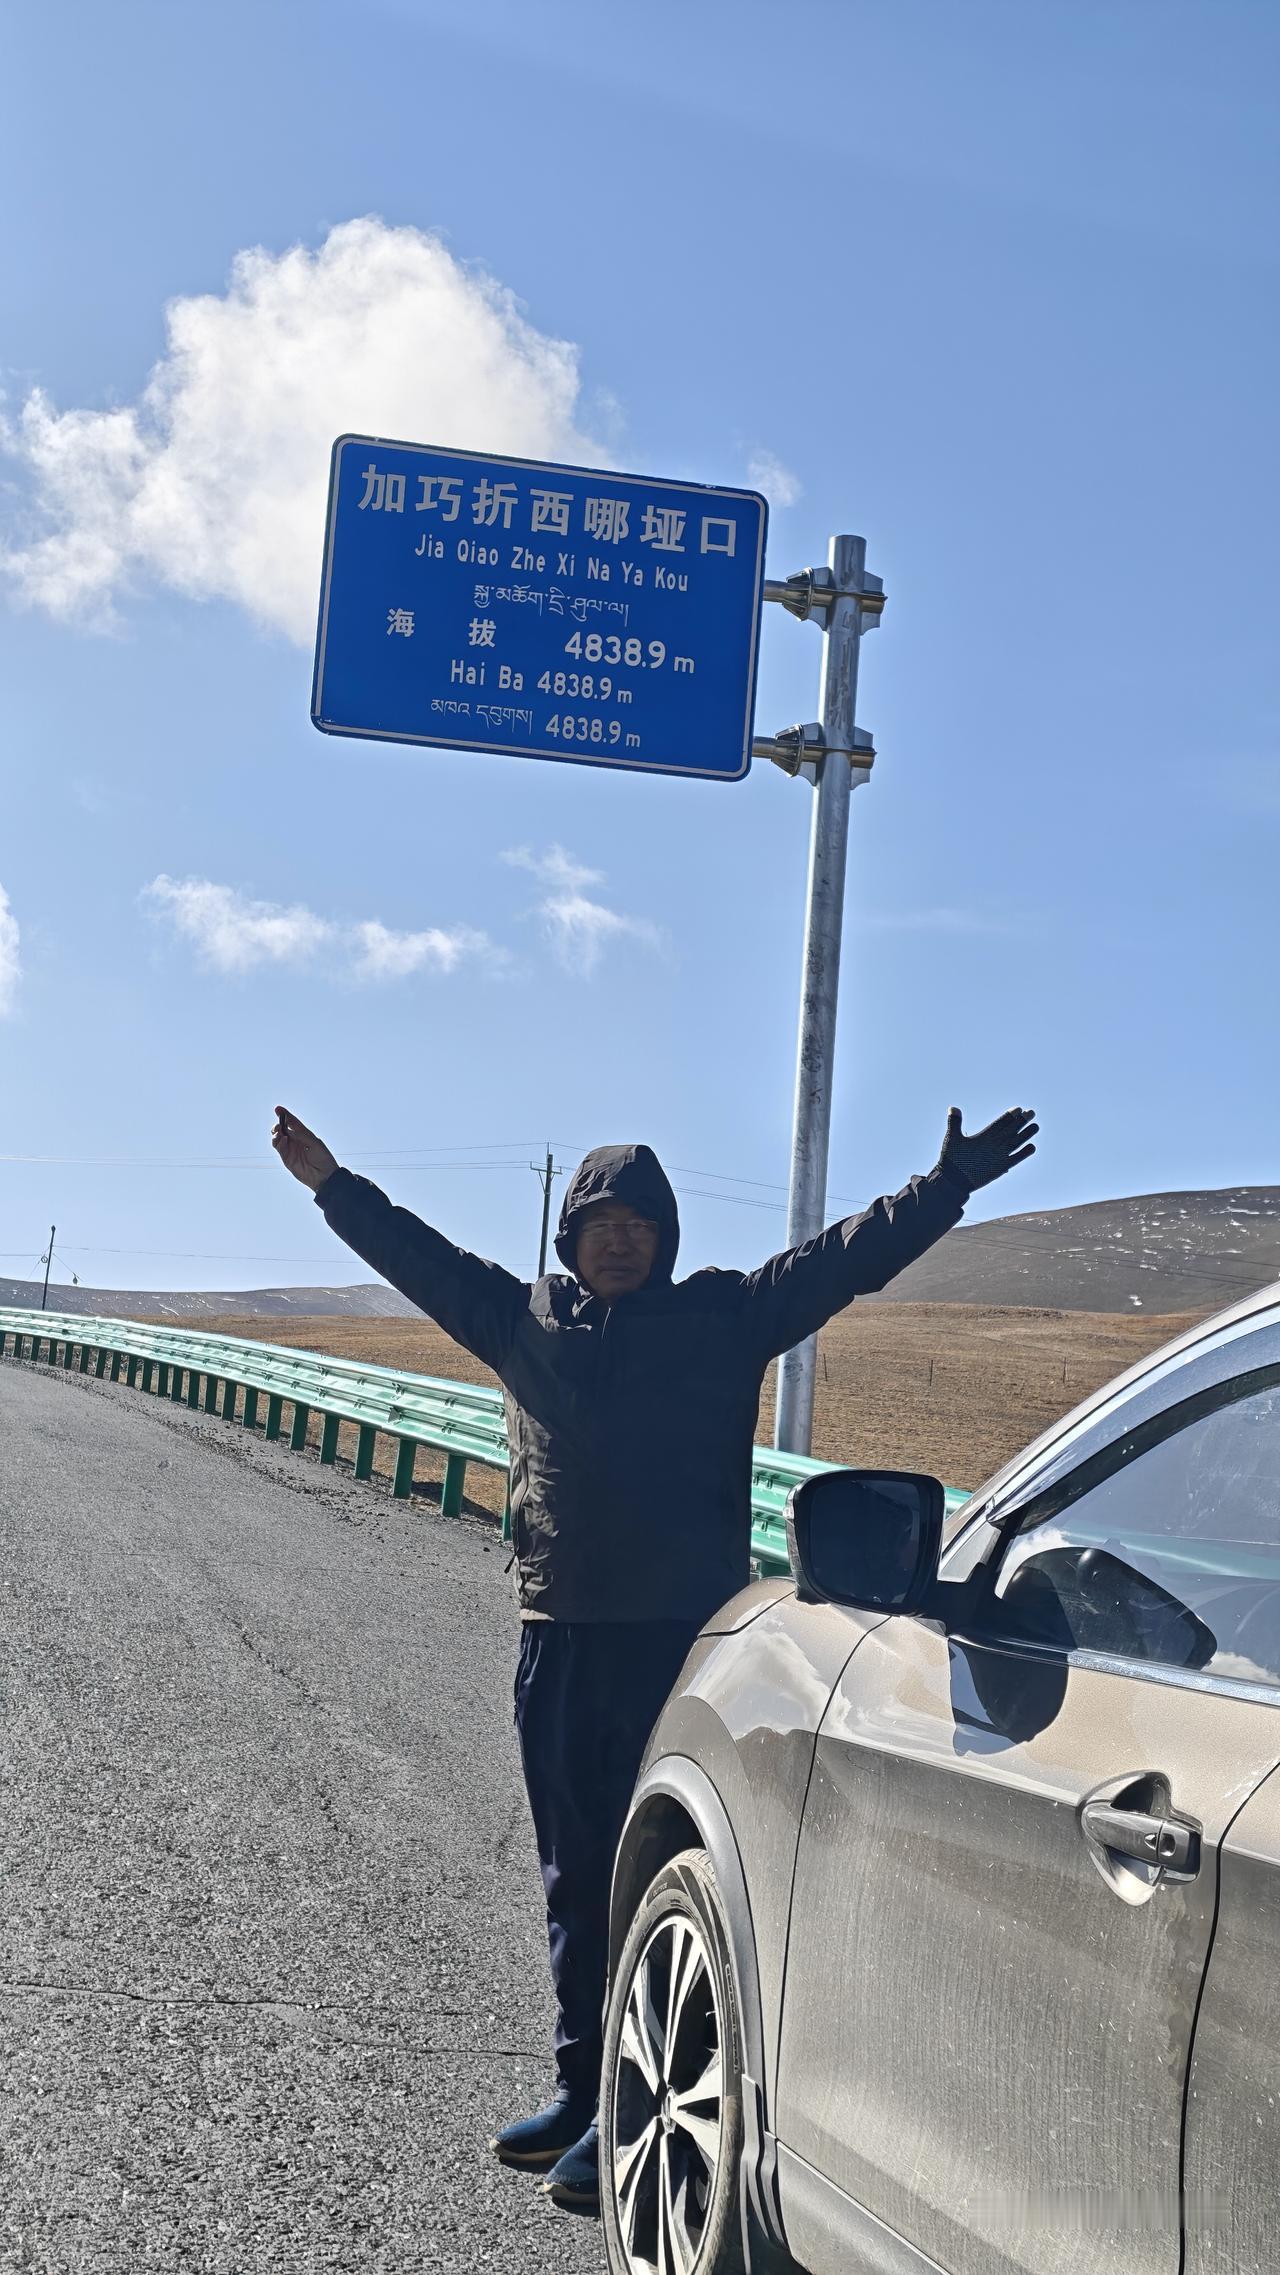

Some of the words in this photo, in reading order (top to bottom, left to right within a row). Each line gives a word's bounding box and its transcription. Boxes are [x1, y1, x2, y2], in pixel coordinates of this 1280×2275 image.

[357, 463, 737, 557] 加巧折西哪垭口
[414, 533, 444, 559] Jia
[457, 539, 499, 567] Qiao
[510, 546, 546, 573] Zhe
[556, 552, 576, 577] Xi
[587, 557, 610, 582] Na
[621, 561, 644, 586] Ya
[654, 566, 689, 592] Kou
[450, 659, 486, 686] Hai
[498, 665, 525, 692] Ba
[564, 631, 667, 669] 4838.9
[673, 656, 695, 674] m
